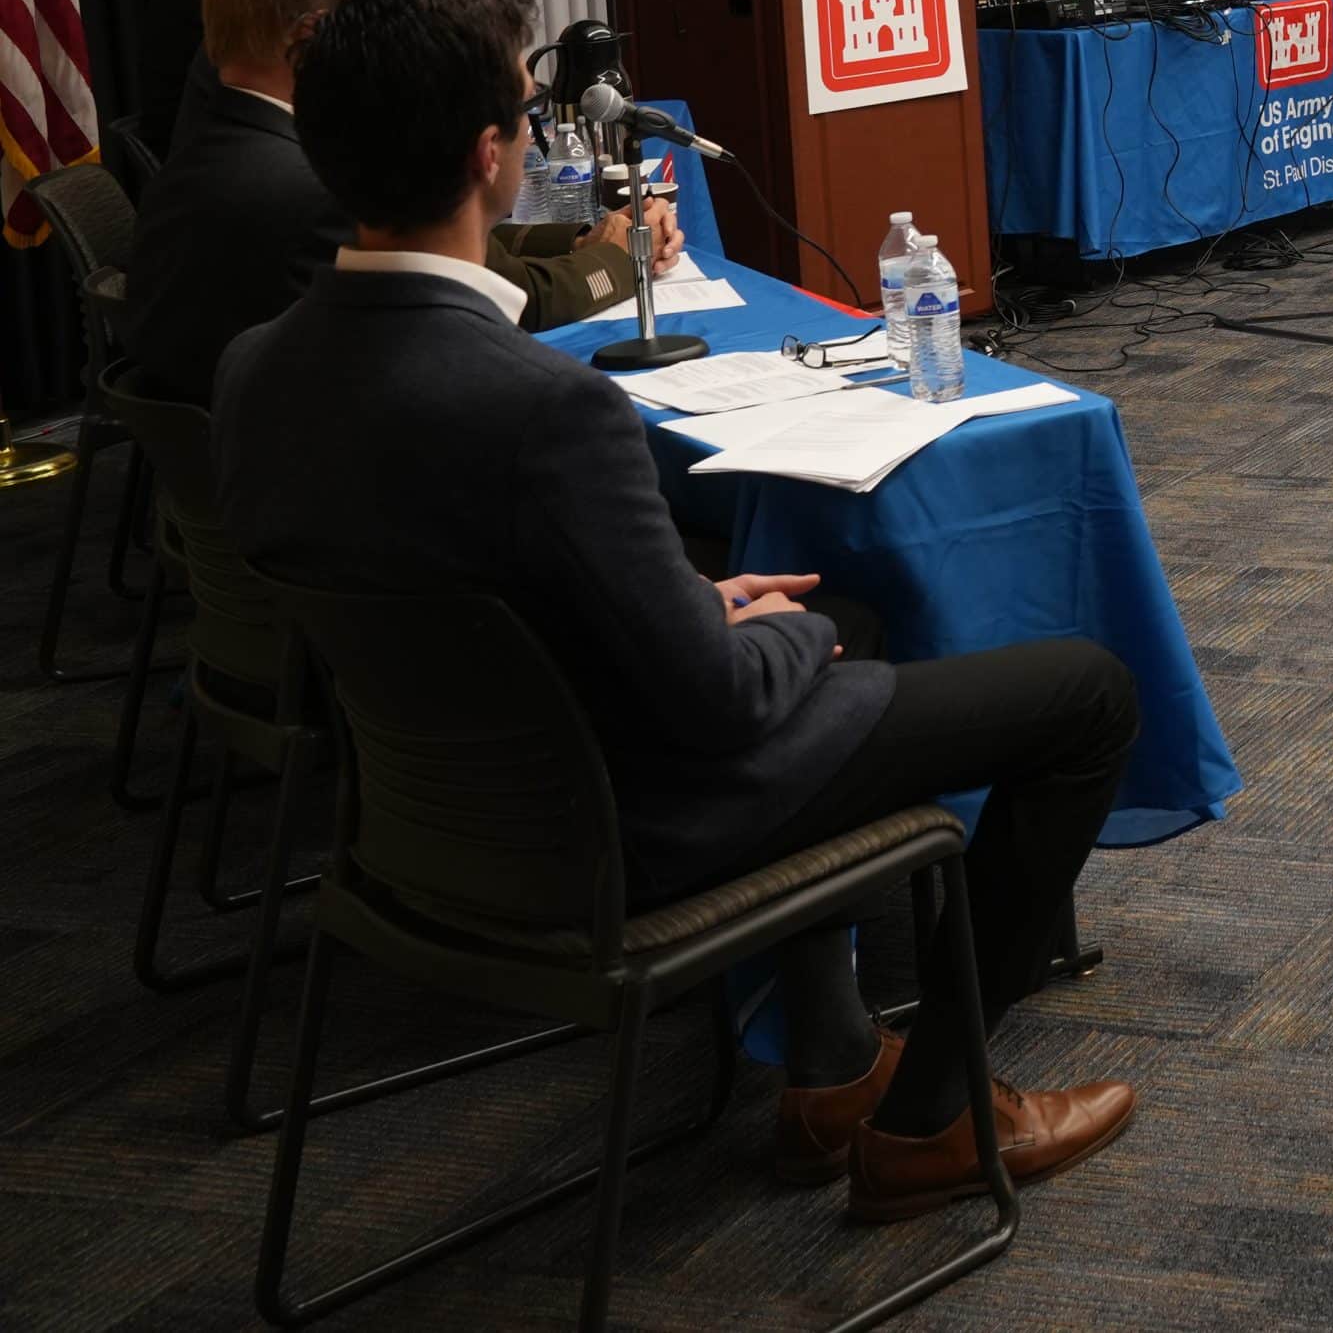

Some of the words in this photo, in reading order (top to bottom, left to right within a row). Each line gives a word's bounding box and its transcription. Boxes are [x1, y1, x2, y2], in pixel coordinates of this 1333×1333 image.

[1259, 100, 1282, 127] US
[1286, 96, 1333, 121] Army
[1261, 132, 1280, 154] of
[1263, 169, 1283, 189] St.
[1285, 160, 1308, 184] Paul
